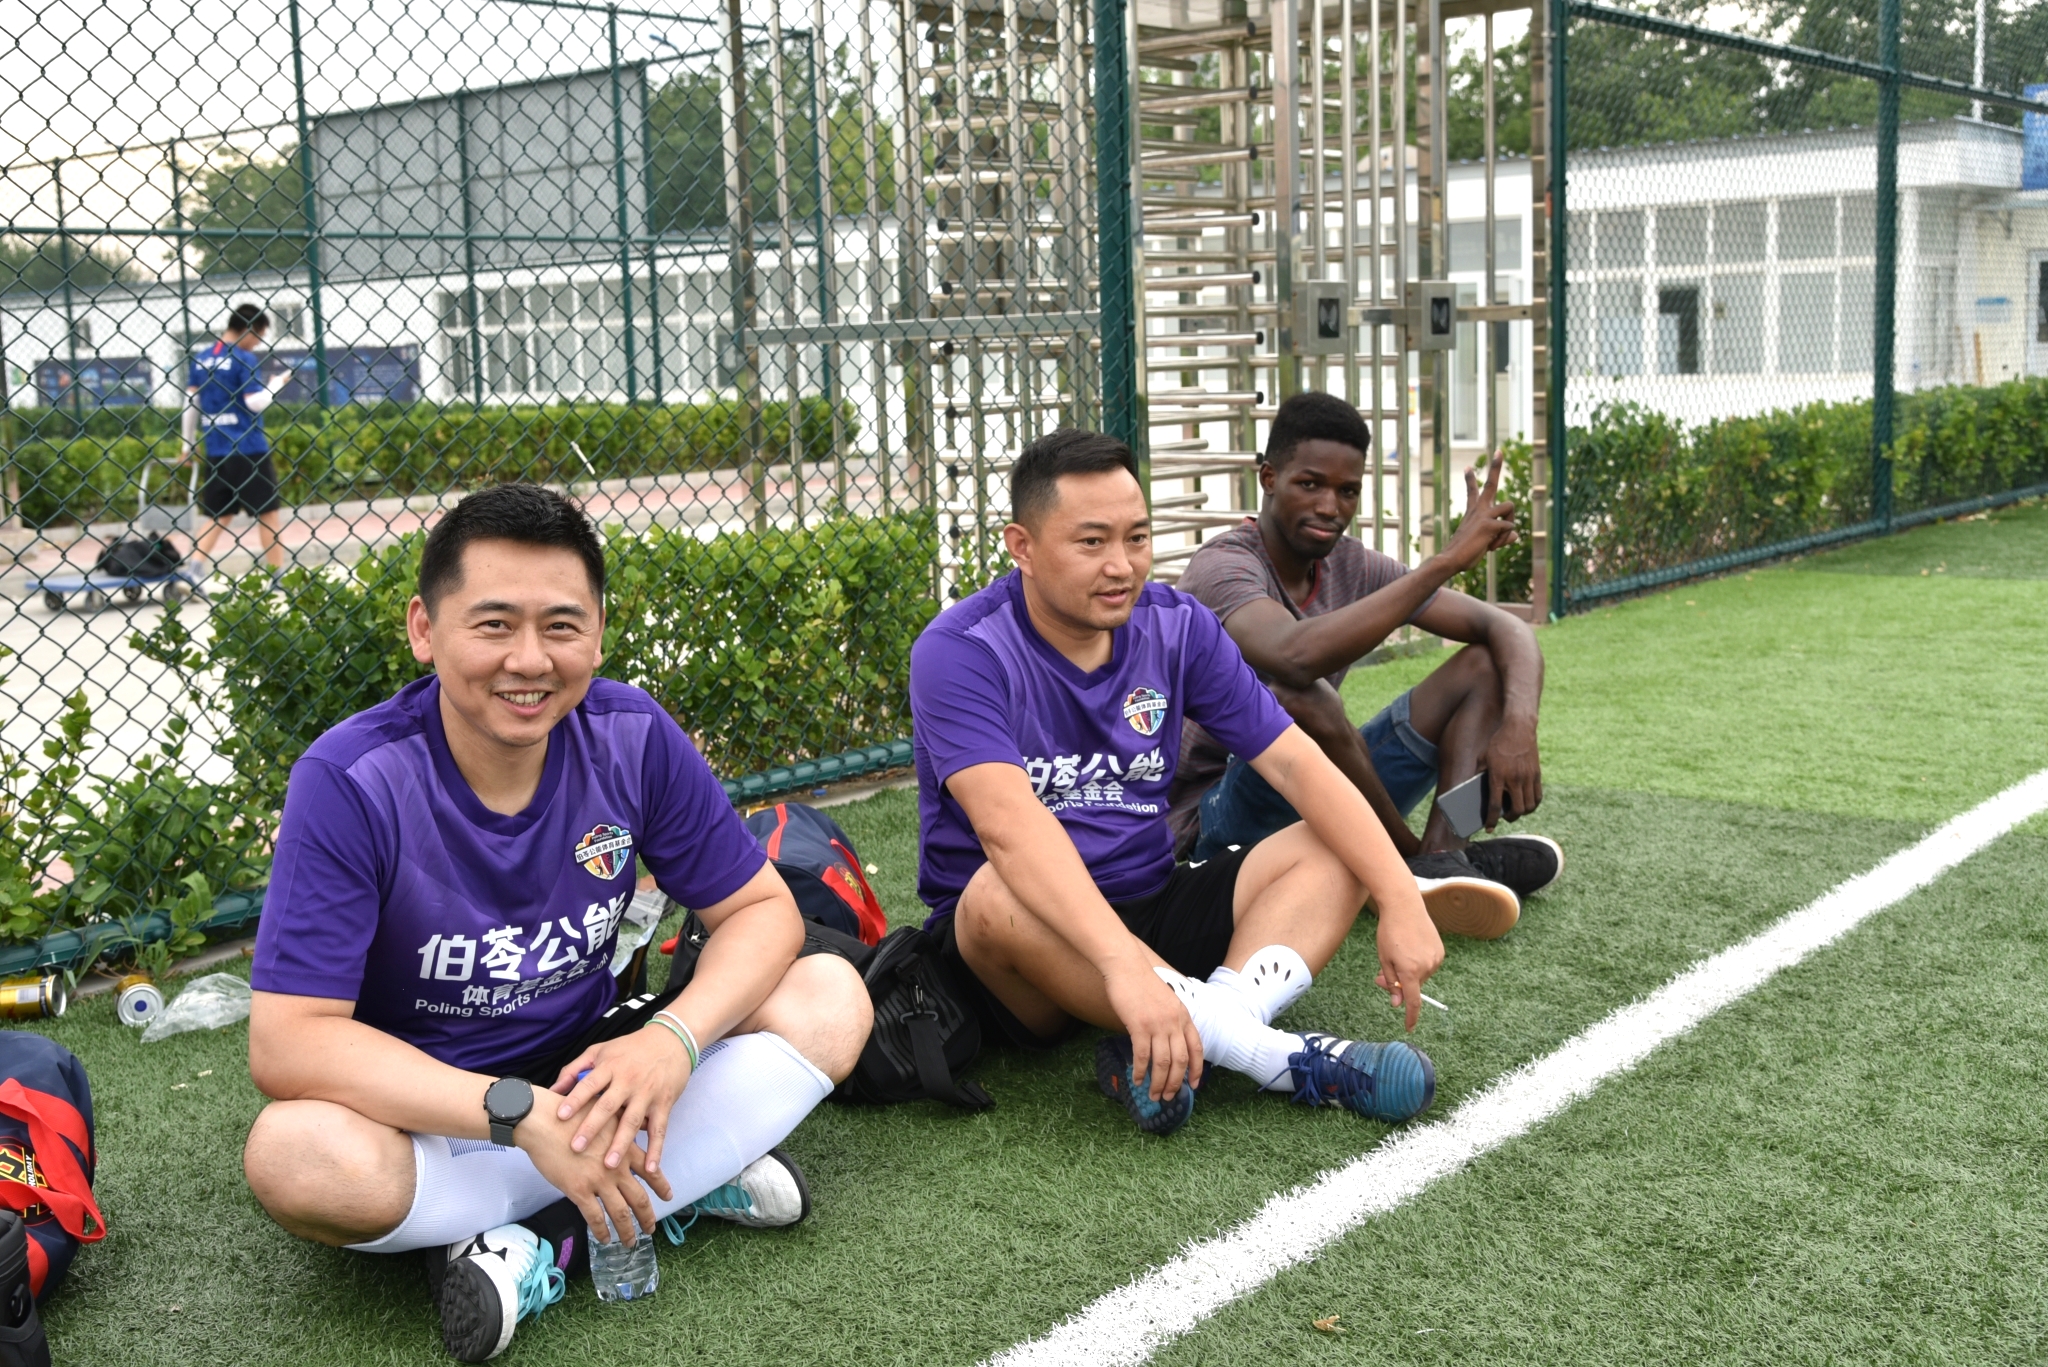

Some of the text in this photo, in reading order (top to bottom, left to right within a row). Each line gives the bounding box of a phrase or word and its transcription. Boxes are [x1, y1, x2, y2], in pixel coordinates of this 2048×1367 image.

[1039, 781, 1124, 805] 基金会
[1046, 801, 1084, 813] ports
[417, 892, 626, 981] 伯苓公能
[415, 952, 609, 1018] Poling Sports Founion
